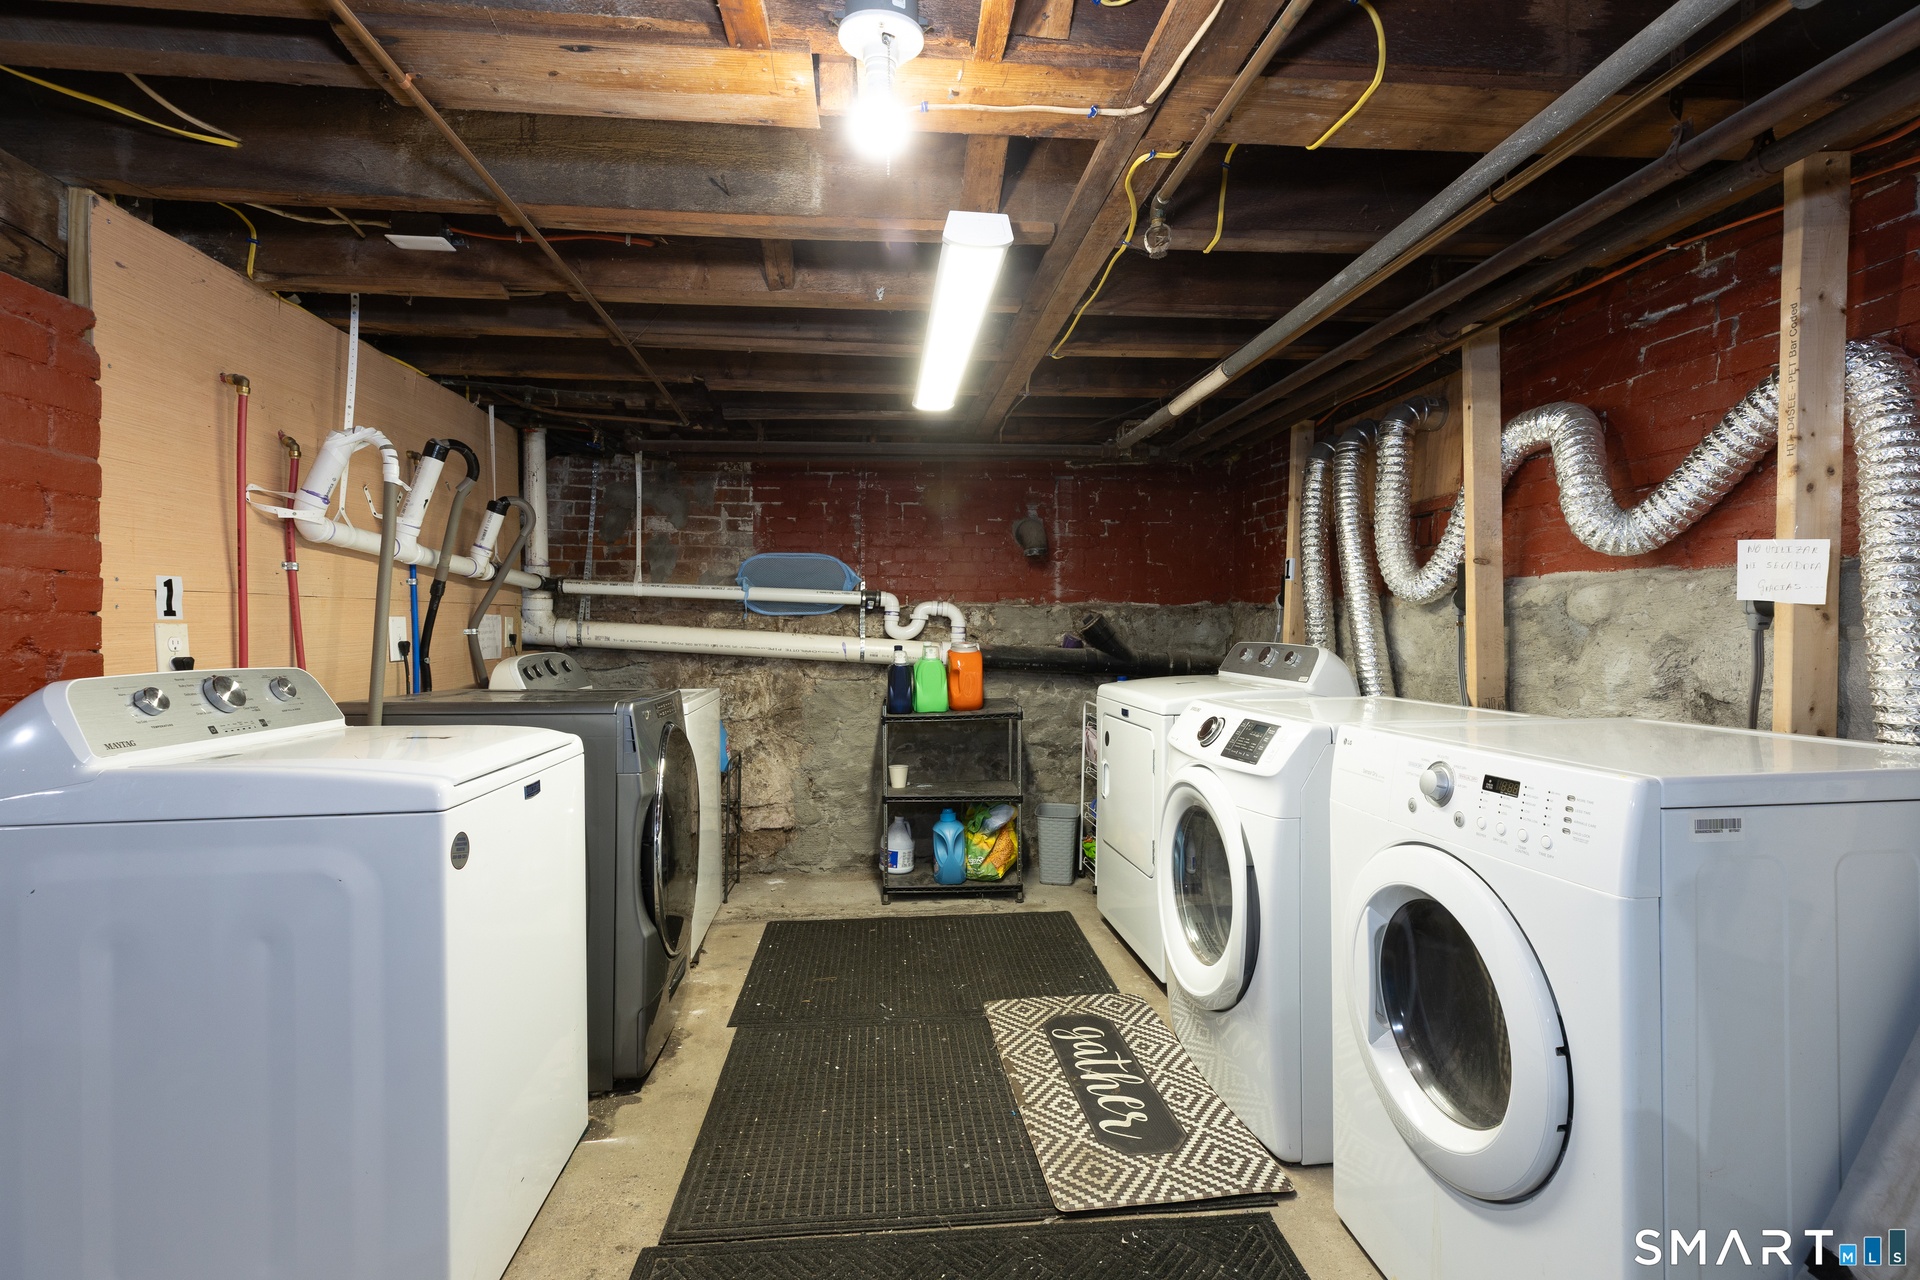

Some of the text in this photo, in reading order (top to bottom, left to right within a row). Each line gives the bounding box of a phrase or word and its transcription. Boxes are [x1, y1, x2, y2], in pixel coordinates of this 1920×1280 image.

[1789, 301, 1799, 337] Coded
[1789, 338, 1798, 359] Bar
[1788, 362, 1797, 384] PET
[1787, 393, 1796, 432] D4SEE
[1747, 543, 1761, 554] NO
[163, 578, 177, 617] 1
[104, 739, 137, 751] MAYTAG
[1051, 1025, 1150, 1140] gather
